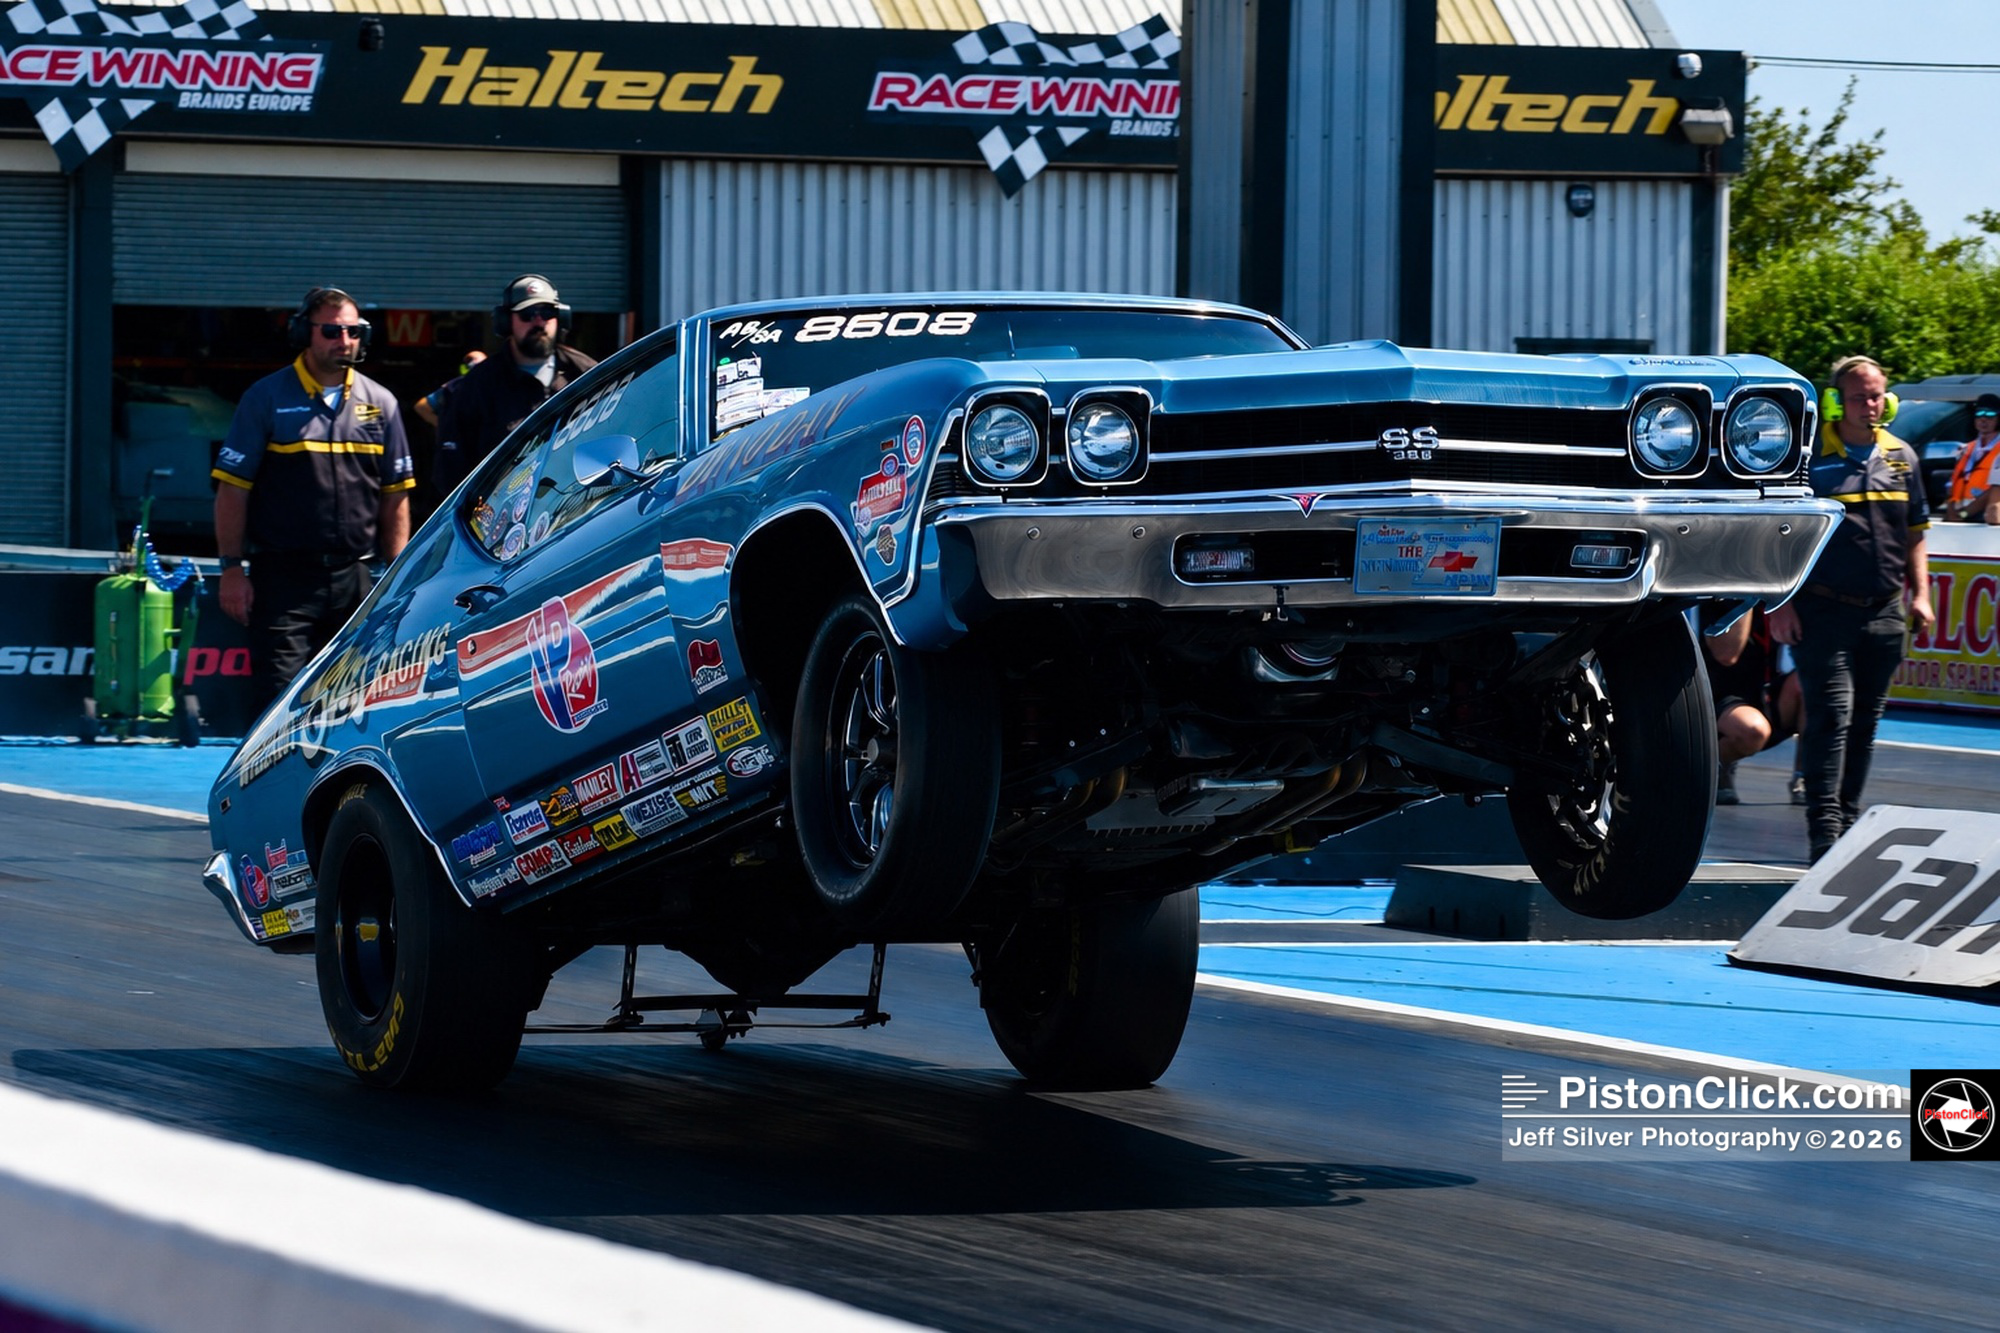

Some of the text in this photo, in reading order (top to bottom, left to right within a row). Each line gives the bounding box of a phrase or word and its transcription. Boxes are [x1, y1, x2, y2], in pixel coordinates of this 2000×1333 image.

[90, 51, 317, 90] WINNING
[401, 45, 784, 113] Haltech
[179, 92, 312, 112] BRANDS EUROPE
[872, 76, 1023, 110] RACE
[1109, 119, 1171, 136] BRANDS
[794, 311, 978, 343] 8608
[1381, 425, 1440, 450] SS
[1398, 546, 1423, 558] THE
